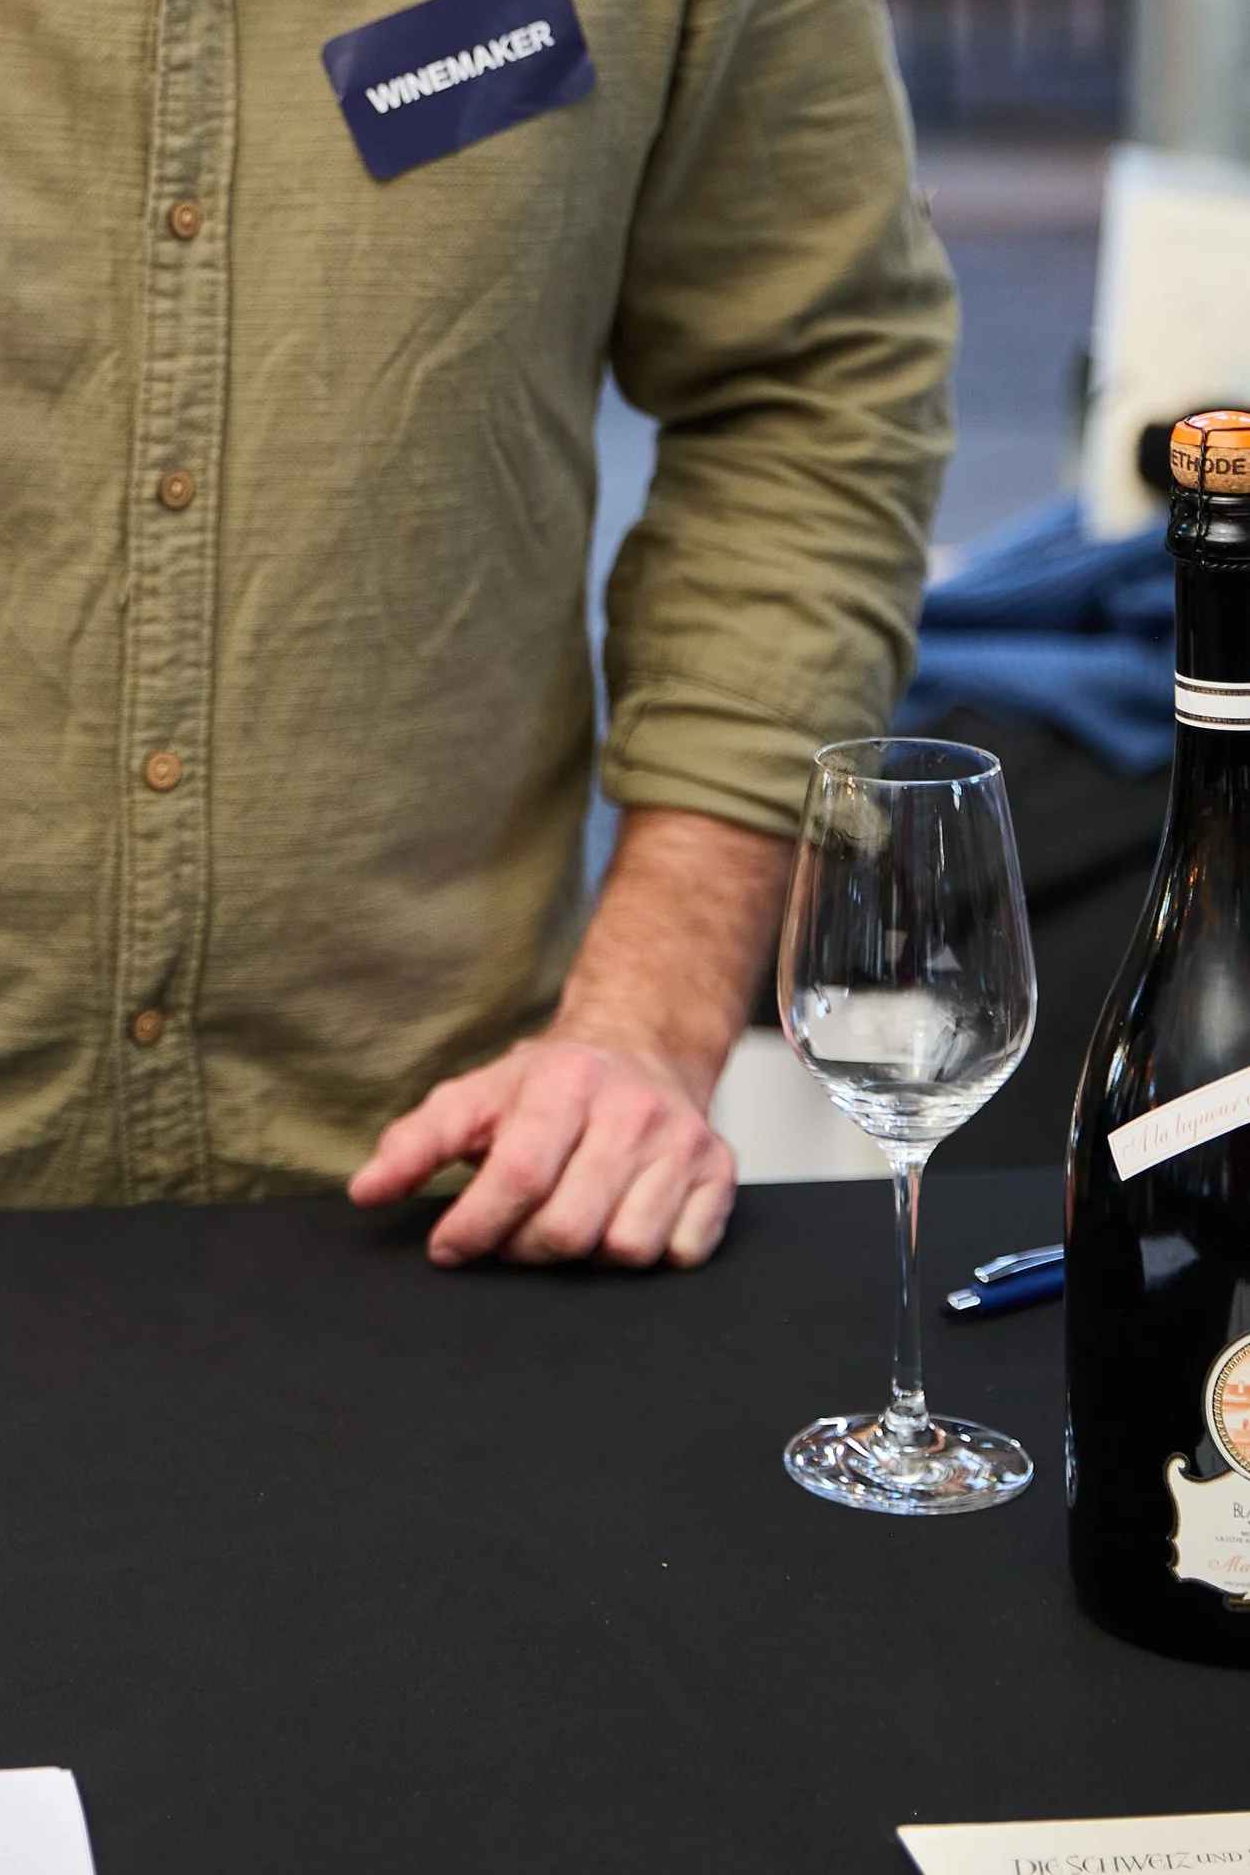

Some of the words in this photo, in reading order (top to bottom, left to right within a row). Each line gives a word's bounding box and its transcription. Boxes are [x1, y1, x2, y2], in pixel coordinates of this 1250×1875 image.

[365, 21, 555, 113] WINEMAKER
[1154, 1123, 1169, 1146] la
[1176, 1100, 1240, 1141] liqueur
[1014, 1857, 1058, 1875] DIE
[1065, 1852, 1190, 1874] SCHWEIZ
